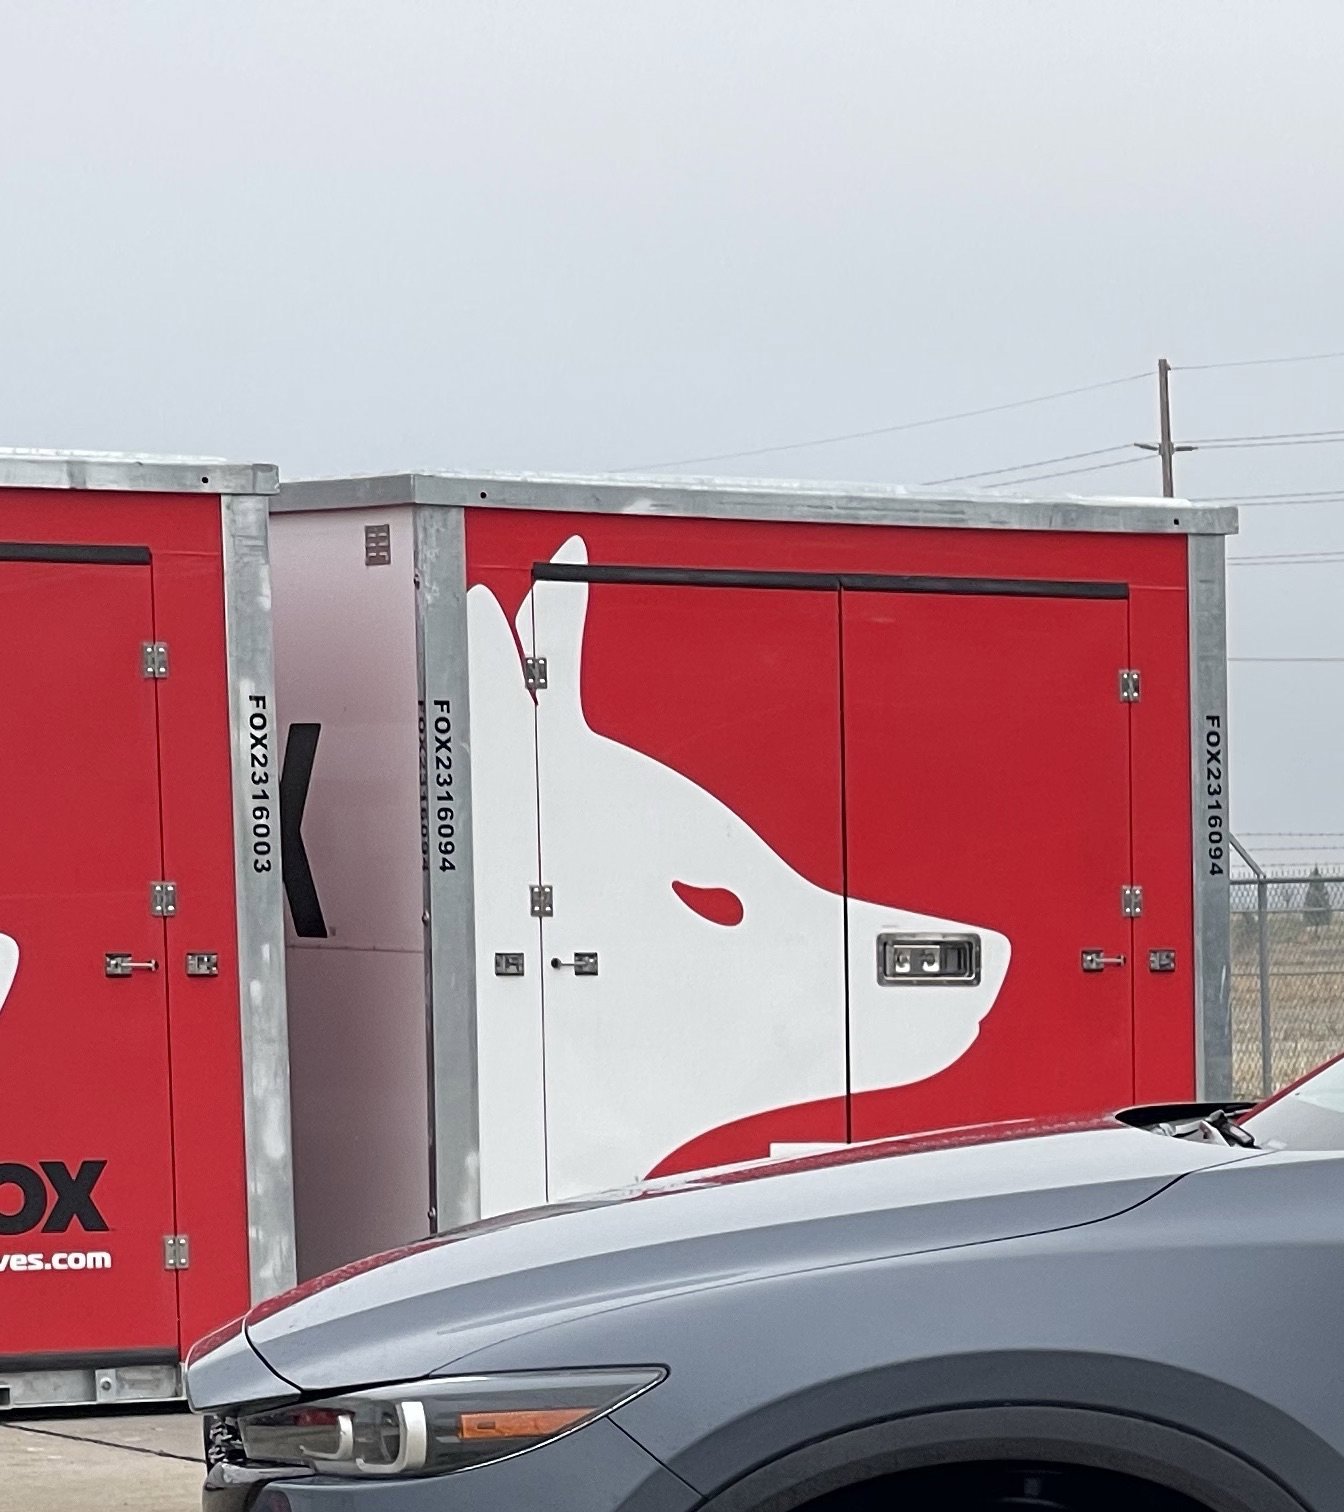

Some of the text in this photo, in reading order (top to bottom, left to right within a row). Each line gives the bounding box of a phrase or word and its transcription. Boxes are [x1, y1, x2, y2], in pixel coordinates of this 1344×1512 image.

[249, 695, 271, 873] FOX2316003
[434, 700, 456, 872] FOX2316094
[1206, 715, 1224, 876] FOX2316094
